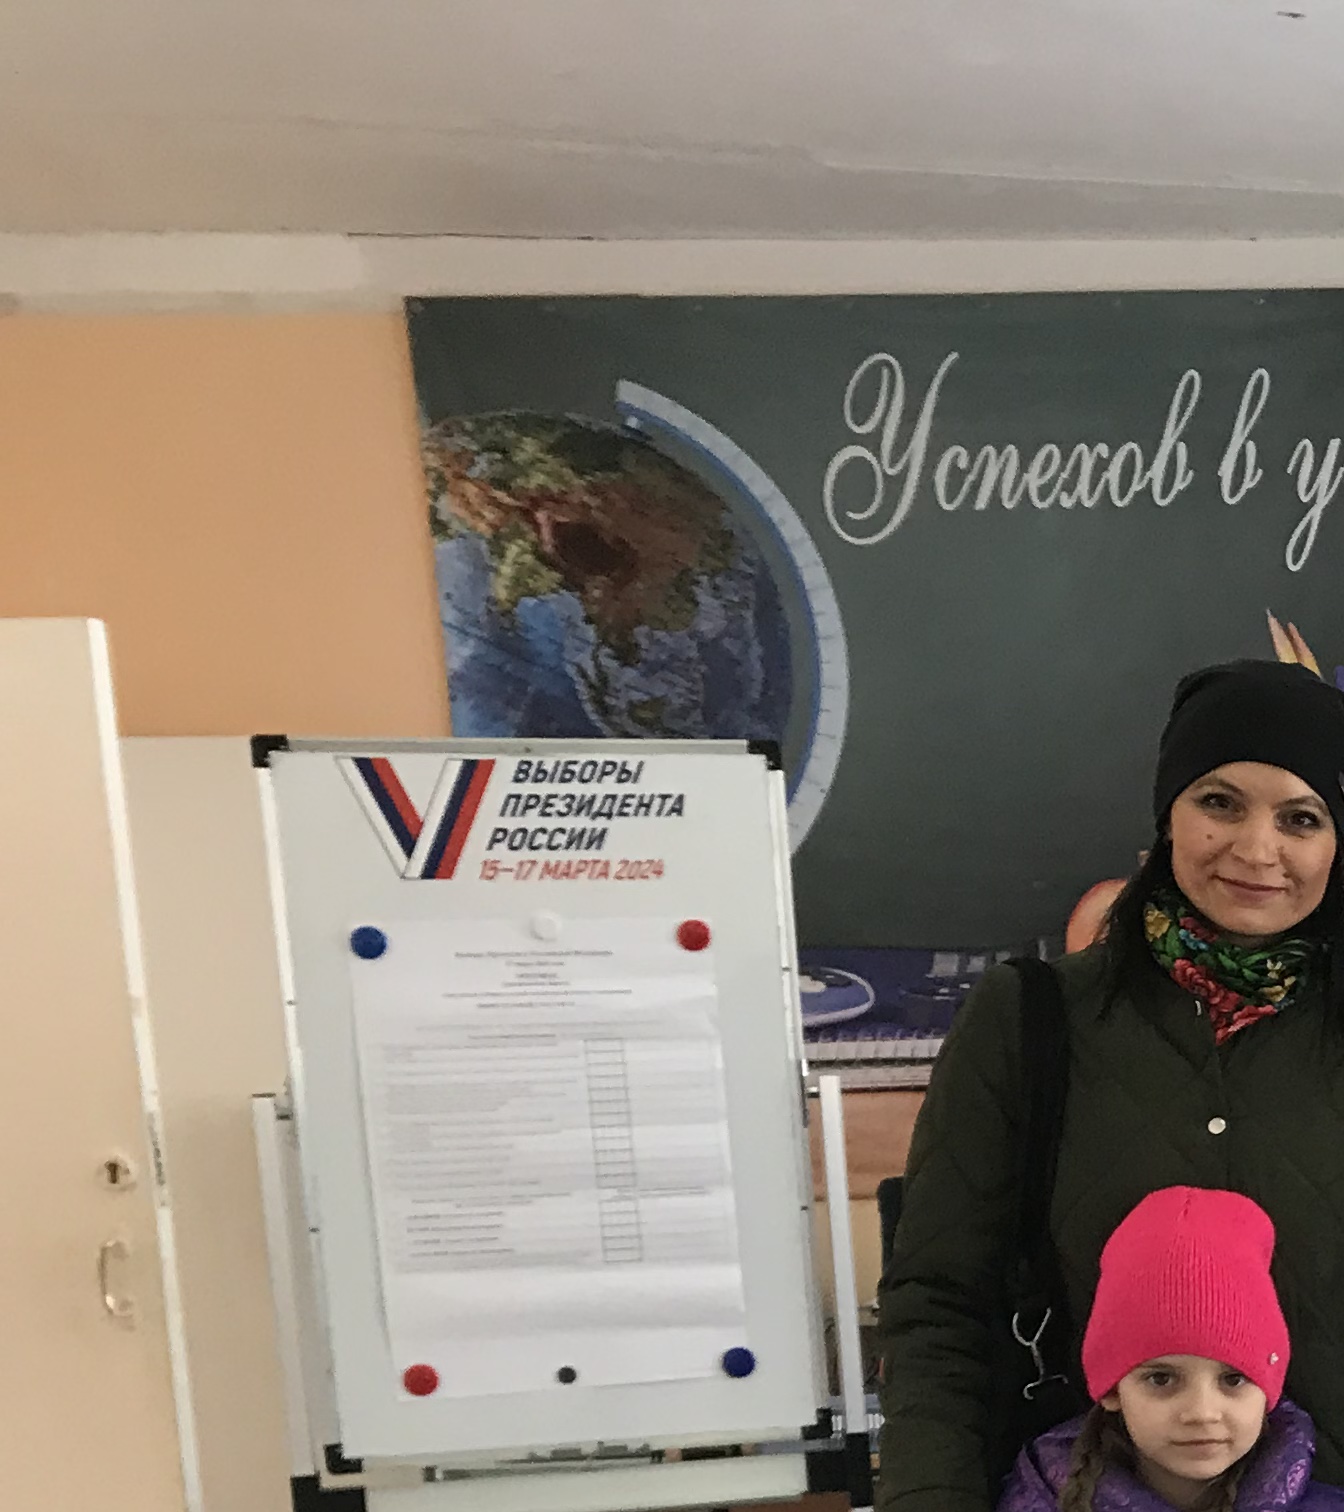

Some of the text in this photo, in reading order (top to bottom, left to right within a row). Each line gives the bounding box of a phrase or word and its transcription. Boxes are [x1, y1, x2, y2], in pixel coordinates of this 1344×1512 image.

[824, 352, 1201, 544] Успехов
[1217, 368, 1270, 504] в
[512, 760, 645, 784] ВЫБОРЫ
[499, 793, 686, 821] ПРЕЗИДЕНТА
[485, 827, 609, 851] РОССИИ
[538, 859, 611, 881] МАРТА
[613, 859, 665, 880] 2024
